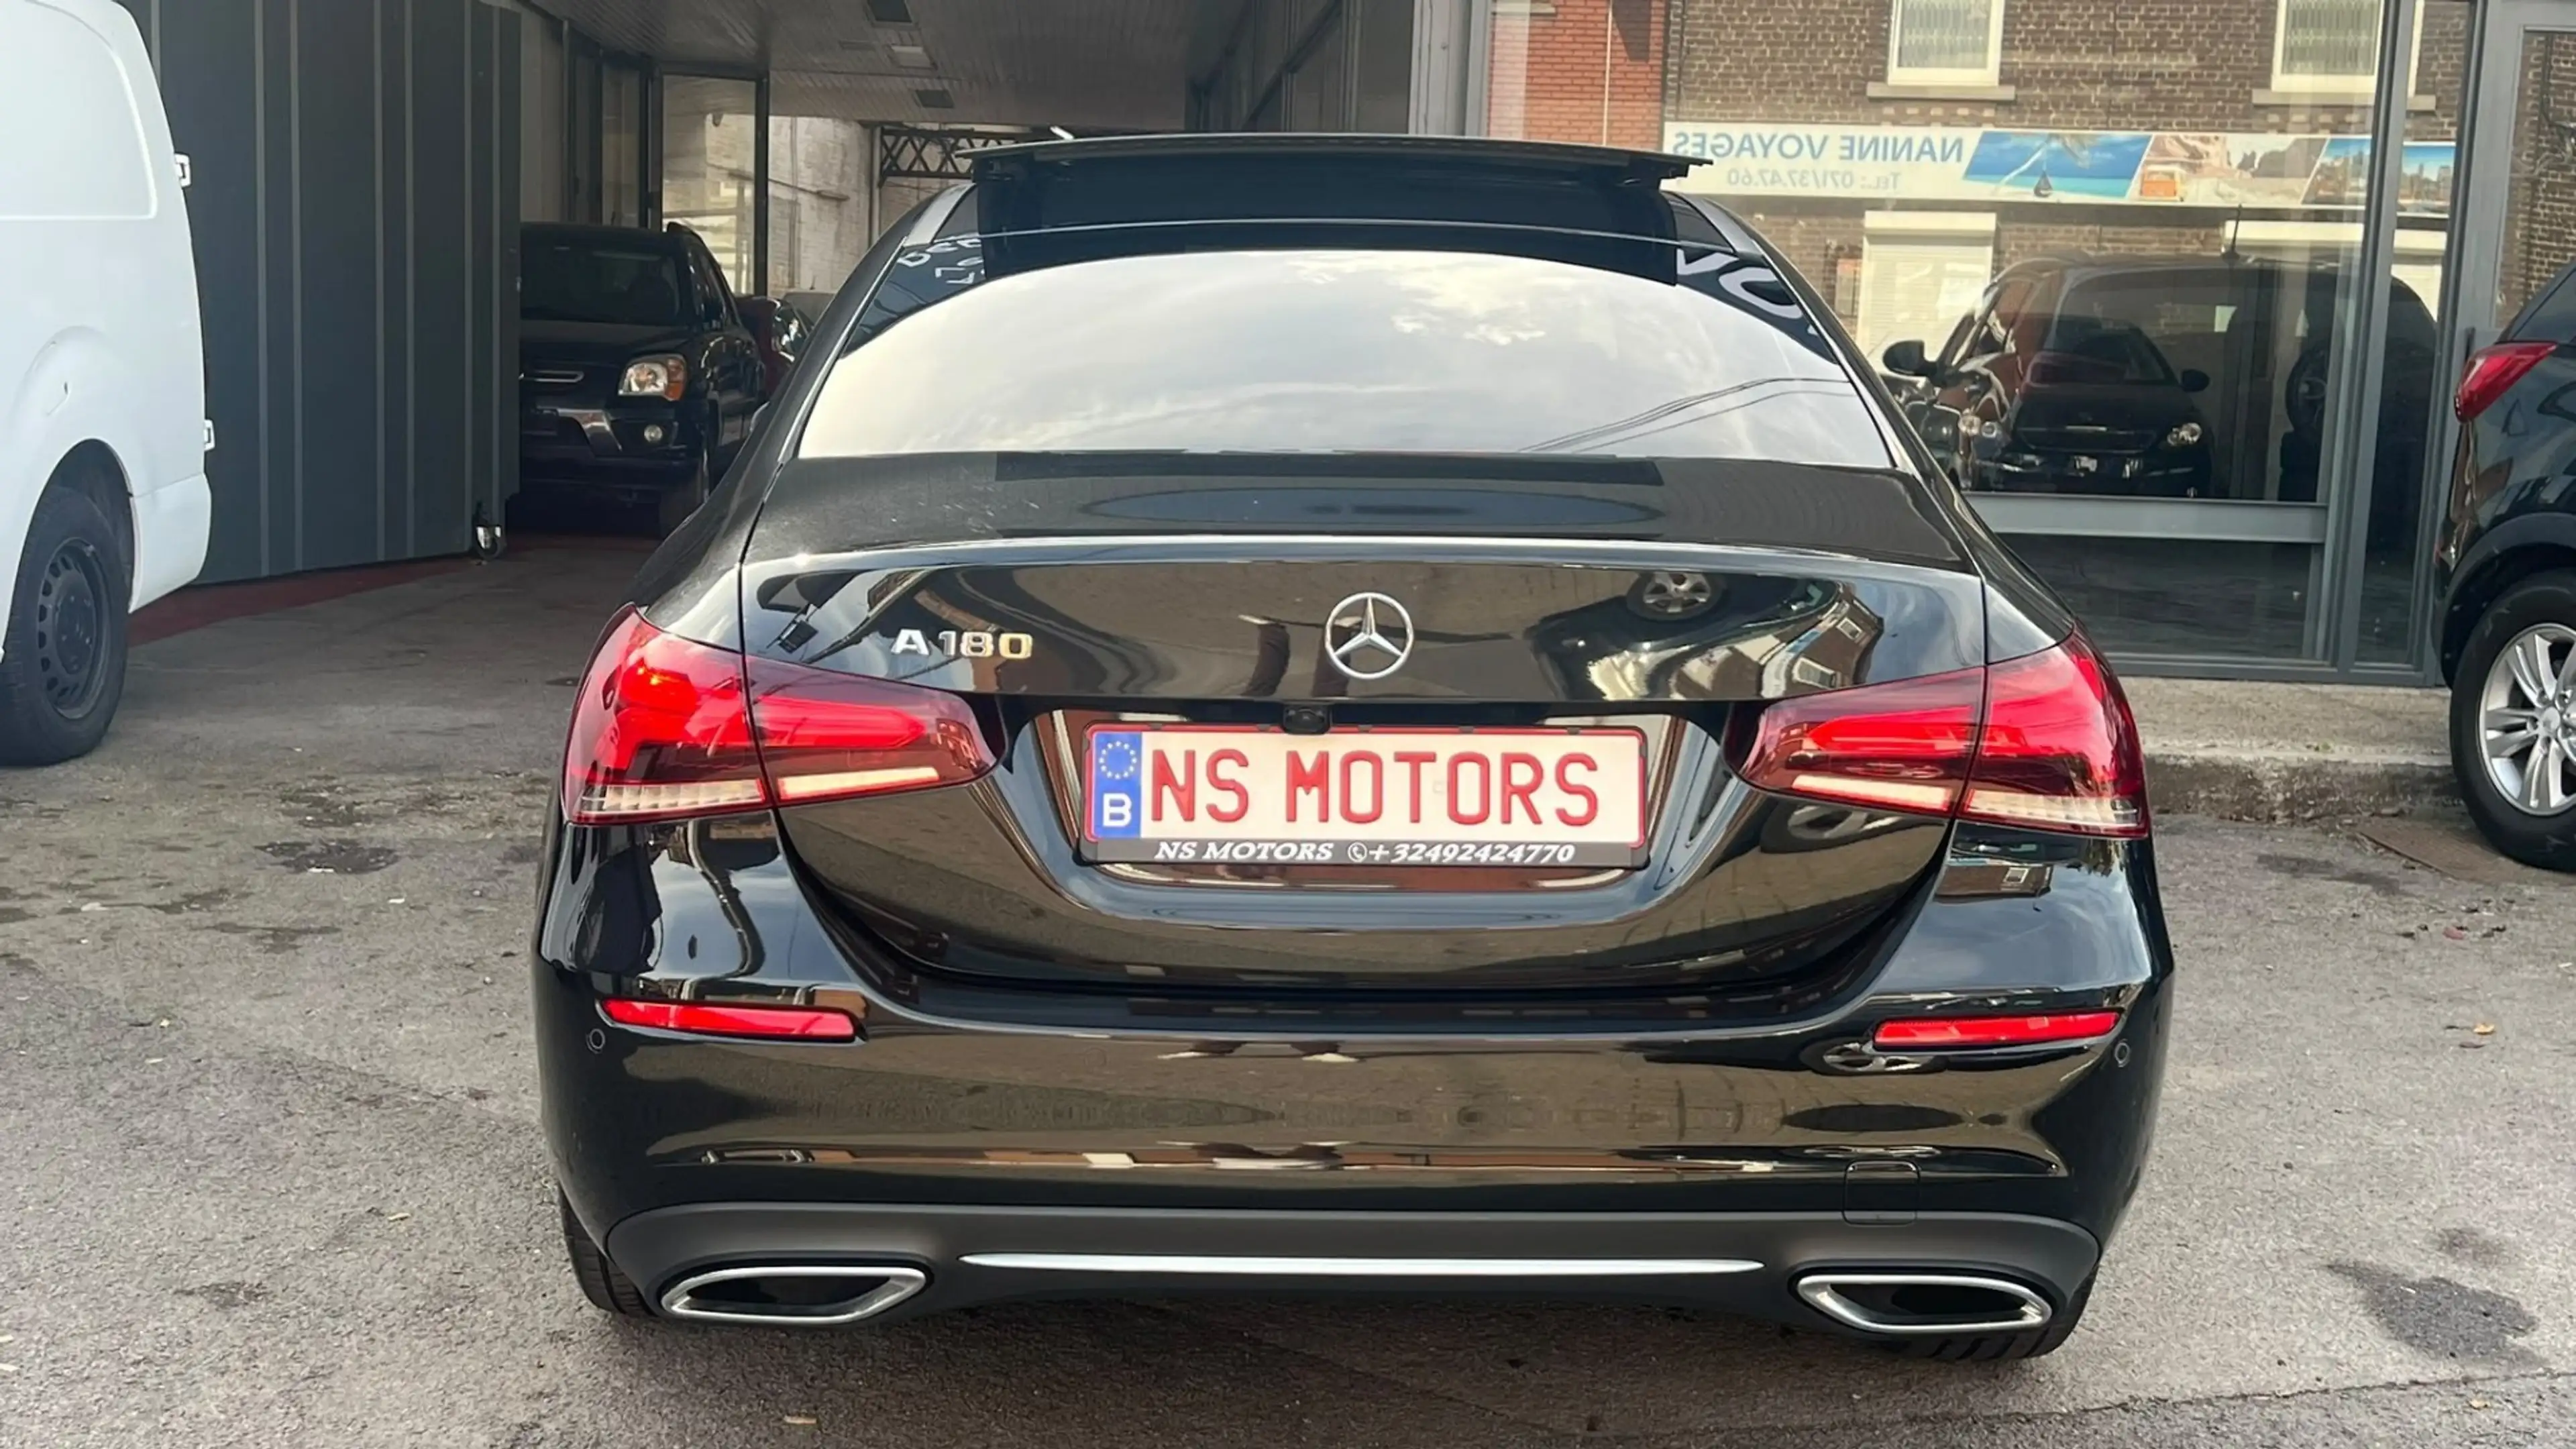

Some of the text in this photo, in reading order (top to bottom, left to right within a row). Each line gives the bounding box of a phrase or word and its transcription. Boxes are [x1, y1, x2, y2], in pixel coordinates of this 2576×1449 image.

[890, 628, 1034, 659] A 180
[1150, 748, 1599, 827] NS MOTORS
[1102, 792, 1132, 827] B
[1154, 841, 1576, 864] NS MOTORS +32492424770
